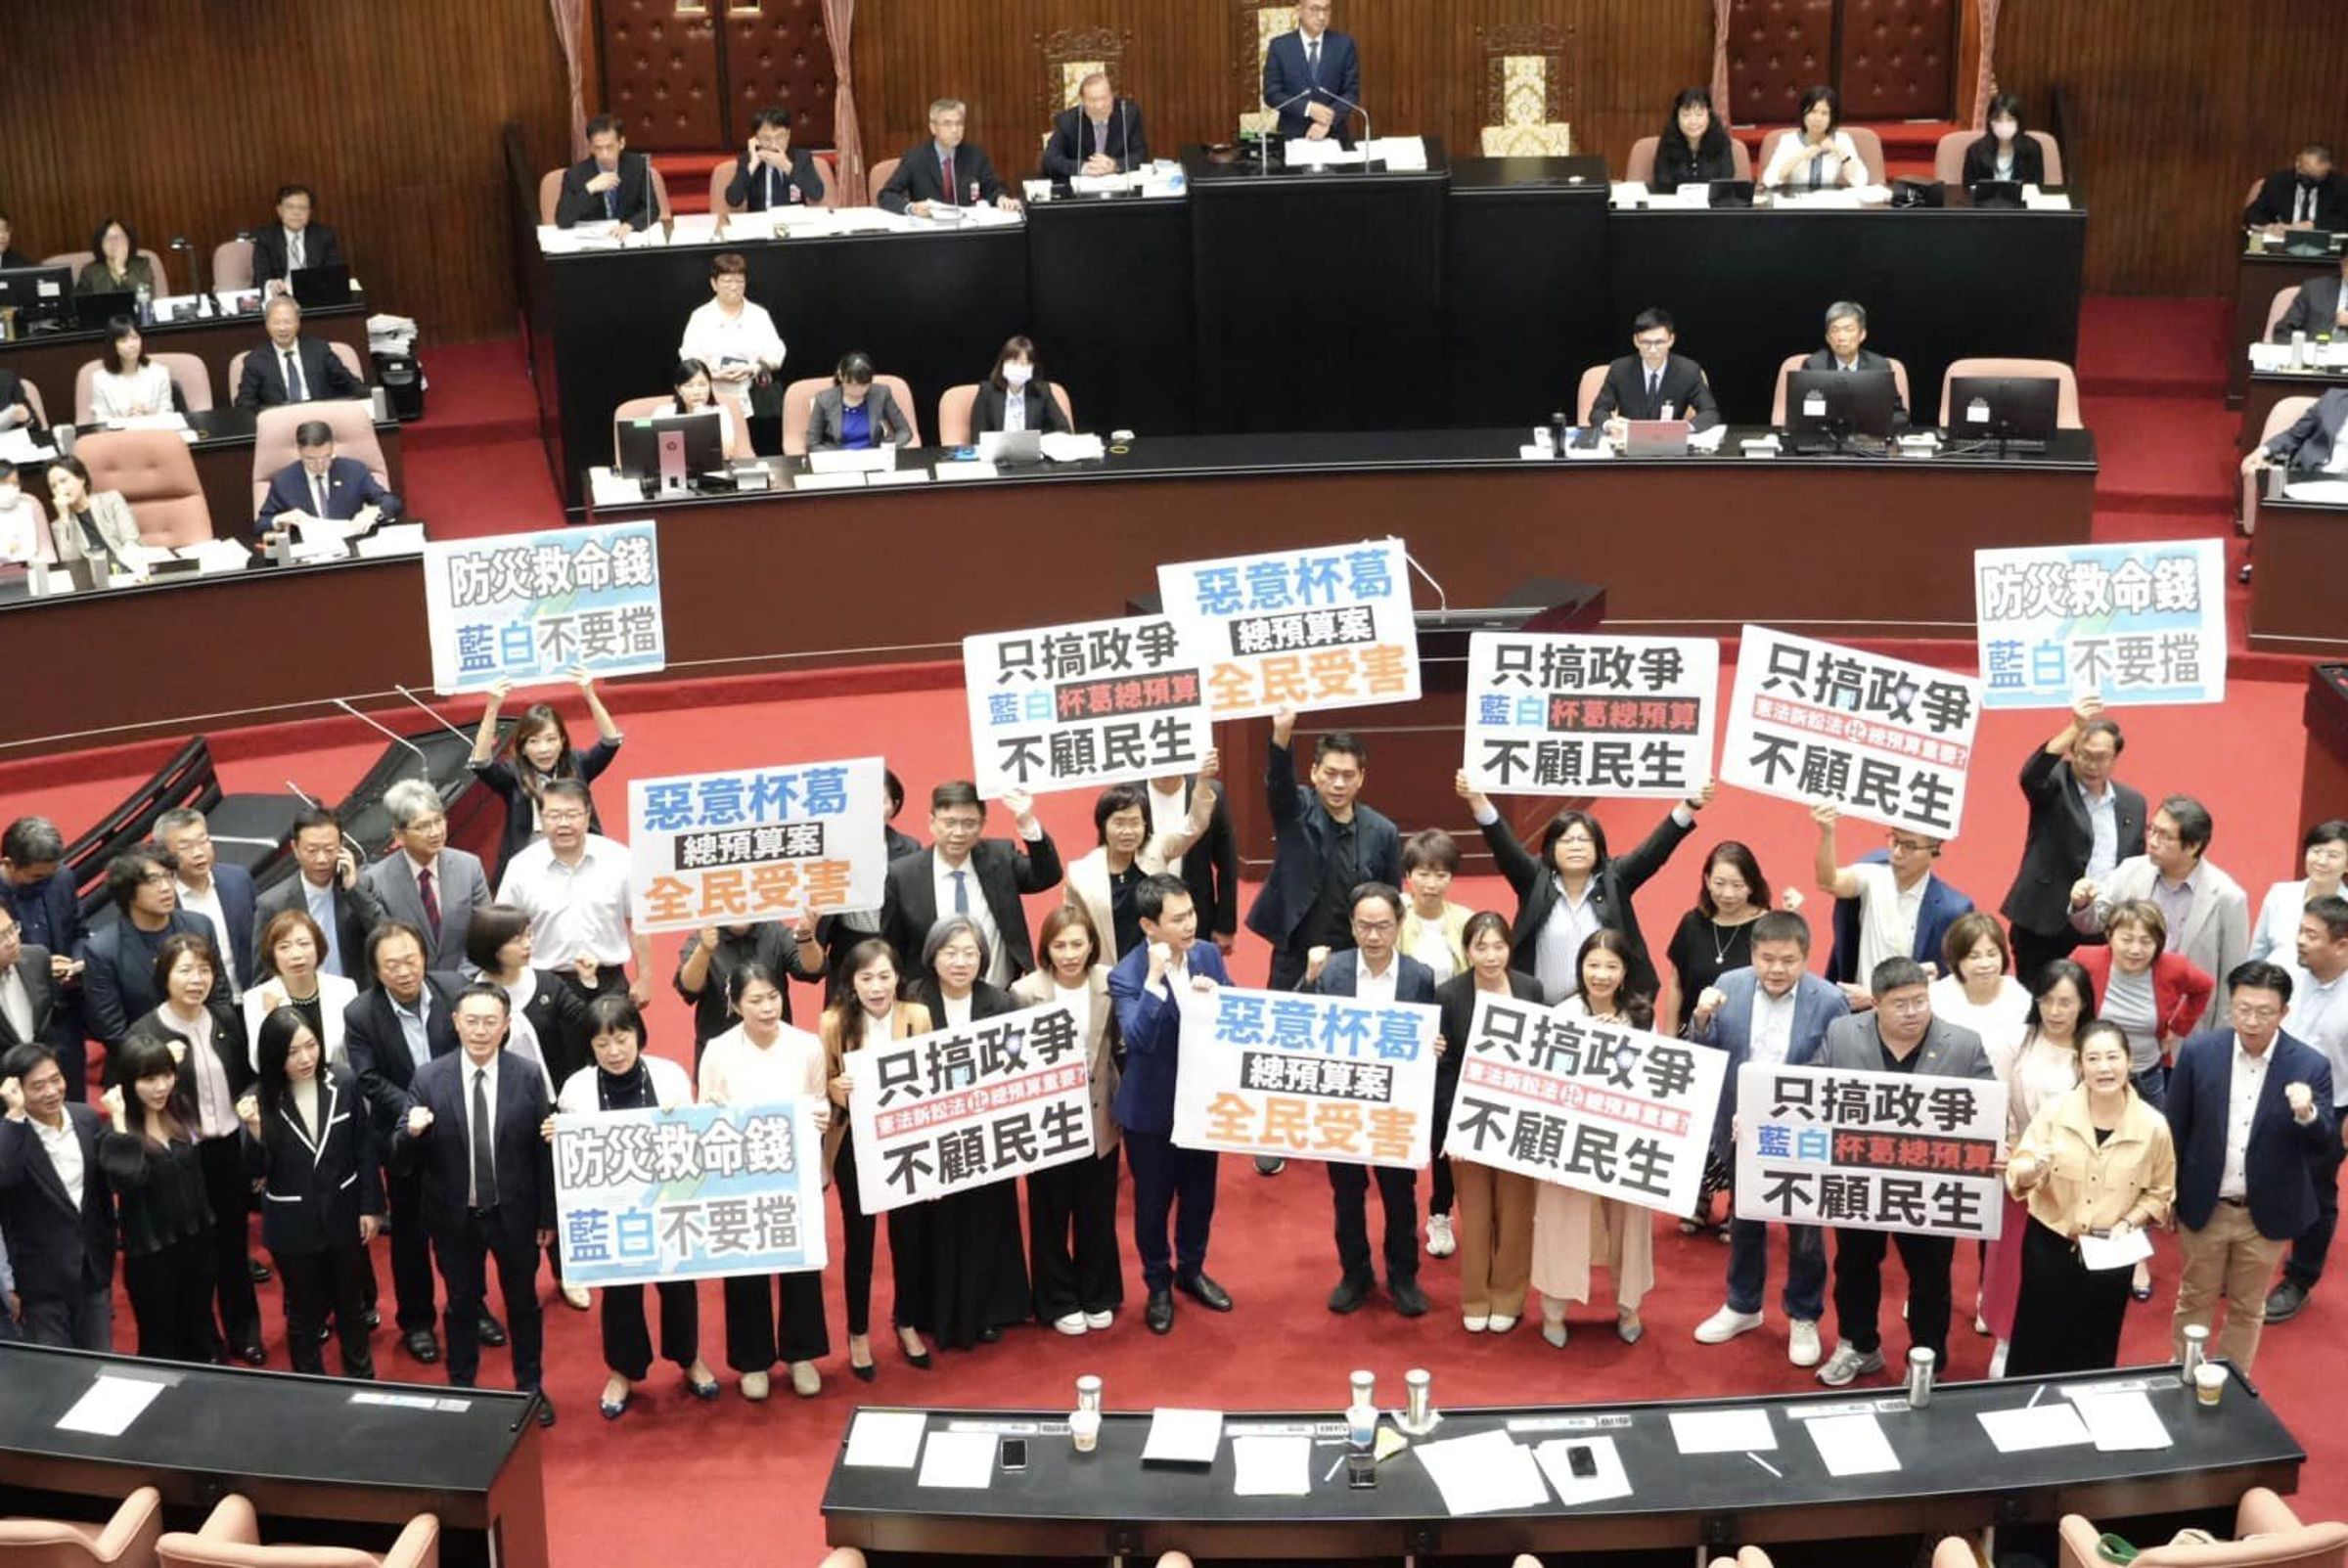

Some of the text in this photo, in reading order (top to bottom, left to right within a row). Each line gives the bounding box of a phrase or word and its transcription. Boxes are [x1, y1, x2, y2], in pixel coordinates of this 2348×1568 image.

[448, 536, 654, 608] 防災救命錢
[1193, 549, 1392, 616] 惡意杯葛
[1981, 557, 2199, 621] 防災救命錢
[456, 605, 657, 673] 藍白不要擋
[997, 621, 1180, 685] 只搞政爭
[1237, 607, 1373, 653] 總預算案
[1986, 632, 2199, 688] 藍白不要擋
[1207, 644, 1409, 712] 全民受害
[1491, 644, 1685, 691] 只搞政爭
[1761, 643, 1972, 733] 只搞政爭
[997, 717, 1197, 784] 不顧民生
[1482, 739, 1686, 788] 不顧民生
[1749, 732, 1955, 830] 不顧民生
[644, 767, 849, 832] 惡意杯葛
[683, 825, 823, 869] 總預算案
[644, 859, 853, 923] 全民受害
[877, 1008, 1078, 1106] 只搞政爭
[1214, 994, 1424, 1061] 惡意杯葛
[1473, 1004, 1696, 1099] 只搞政爭
[1249, 1057, 1392, 1100] 總預算案
[1769, 1076, 1978, 1132] 只搞政爭
[560, 1115, 795, 1189] 防災救命錢
[883, 1100, 1090, 1195] 不顧民生
[1205, 1091, 1419, 1160] 全民受害
[1457, 1096, 1676, 1199] 不顧民生
[565, 1195, 797, 1263] 藍白不要擋
[1762, 1170, 1983, 1232] 不顧民生
